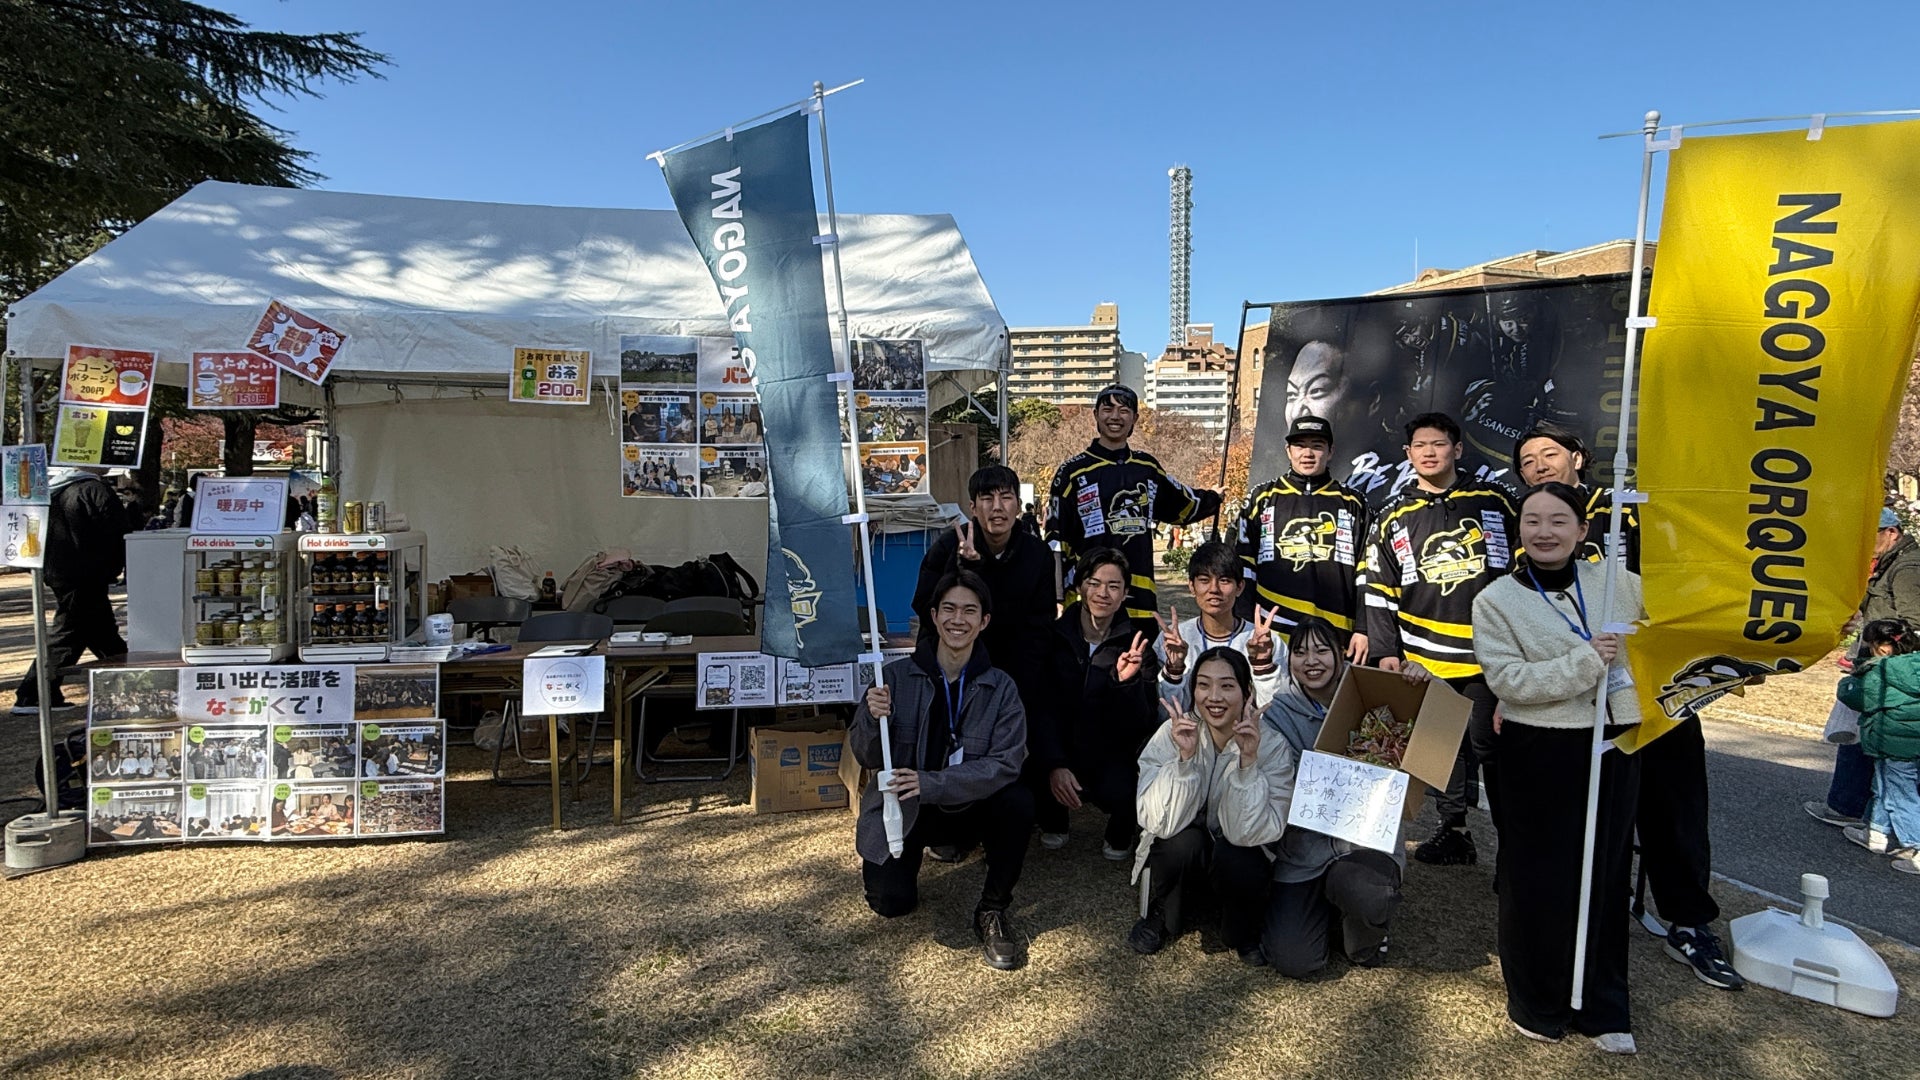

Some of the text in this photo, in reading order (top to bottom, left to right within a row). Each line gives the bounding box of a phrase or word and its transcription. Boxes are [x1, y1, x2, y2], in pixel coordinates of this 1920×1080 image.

[1755, 192, 1842, 431] NAGOYA
[526, 353, 579, 362] お得で嬉しい
[77, 362, 114, 374] コーン
[548, 365, 577, 379] お茶
[70, 373, 115, 385] ポタージュ
[223, 372, 274, 384] コーヒー
[81, 385, 105, 395] 200円
[538, 383, 583, 396] 200円
[236, 393, 267, 404] 150円
[72, 411, 97, 420] ホット
[216, 499, 264, 512] 暖房中
[192, 538, 236, 547] Hot drinks
[306, 538, 349, 547] Hot drinks
[1742, 447, 1812, 646] ORQUES
[196, 670, 341, 690] 思い出と活躍を
[206, 695, 324, 716] なごがくで！
[809, 748, 839, 756] POCAR
